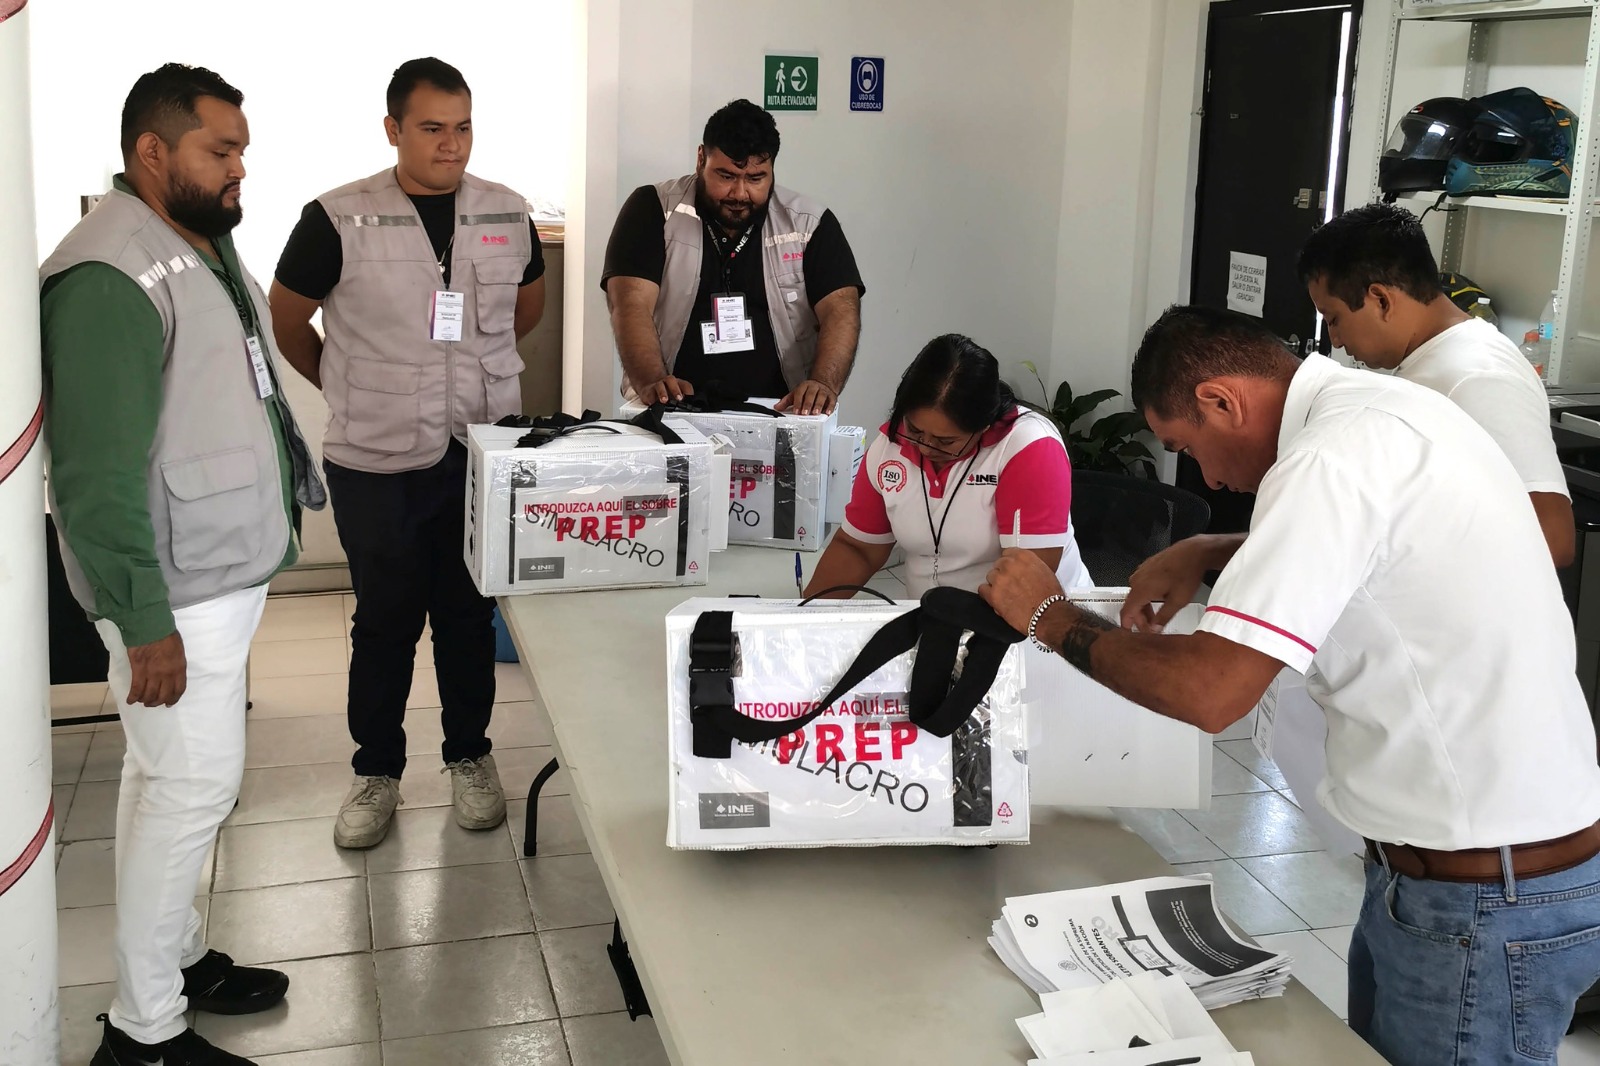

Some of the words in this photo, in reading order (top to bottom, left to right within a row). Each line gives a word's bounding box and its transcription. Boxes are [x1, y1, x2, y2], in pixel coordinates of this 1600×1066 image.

[767, 95, 780, 105] RUTA
[780, 95, 787, 105] DE
[787, 93, 816, 106] EVACUACIÓN
[858, 93, 868, 101] USO
[868, 93, 875, 101] DE
[851, 101, 882, 109] CUBREBOCAS
[884, 470, 900, 481] ISO
[976, 474, 997, 483] INE
[524, 502, 594, 515] INTRODUZCA
[596, 498, 623, 512] AQUÍ
[641, 498, 678, 510] SOBRE
[556, 514, 646, 542] PREP
[525, 504, 665, 568] SIMULACRO
[839, 696, 880, 716] AQUÍ
[884, 699, 906, 715] EL
[779, 722, 918, 764] PREP
[728, 804, 754, 814] INE
[1091, 928, 1119, 965] SOBRANTES
